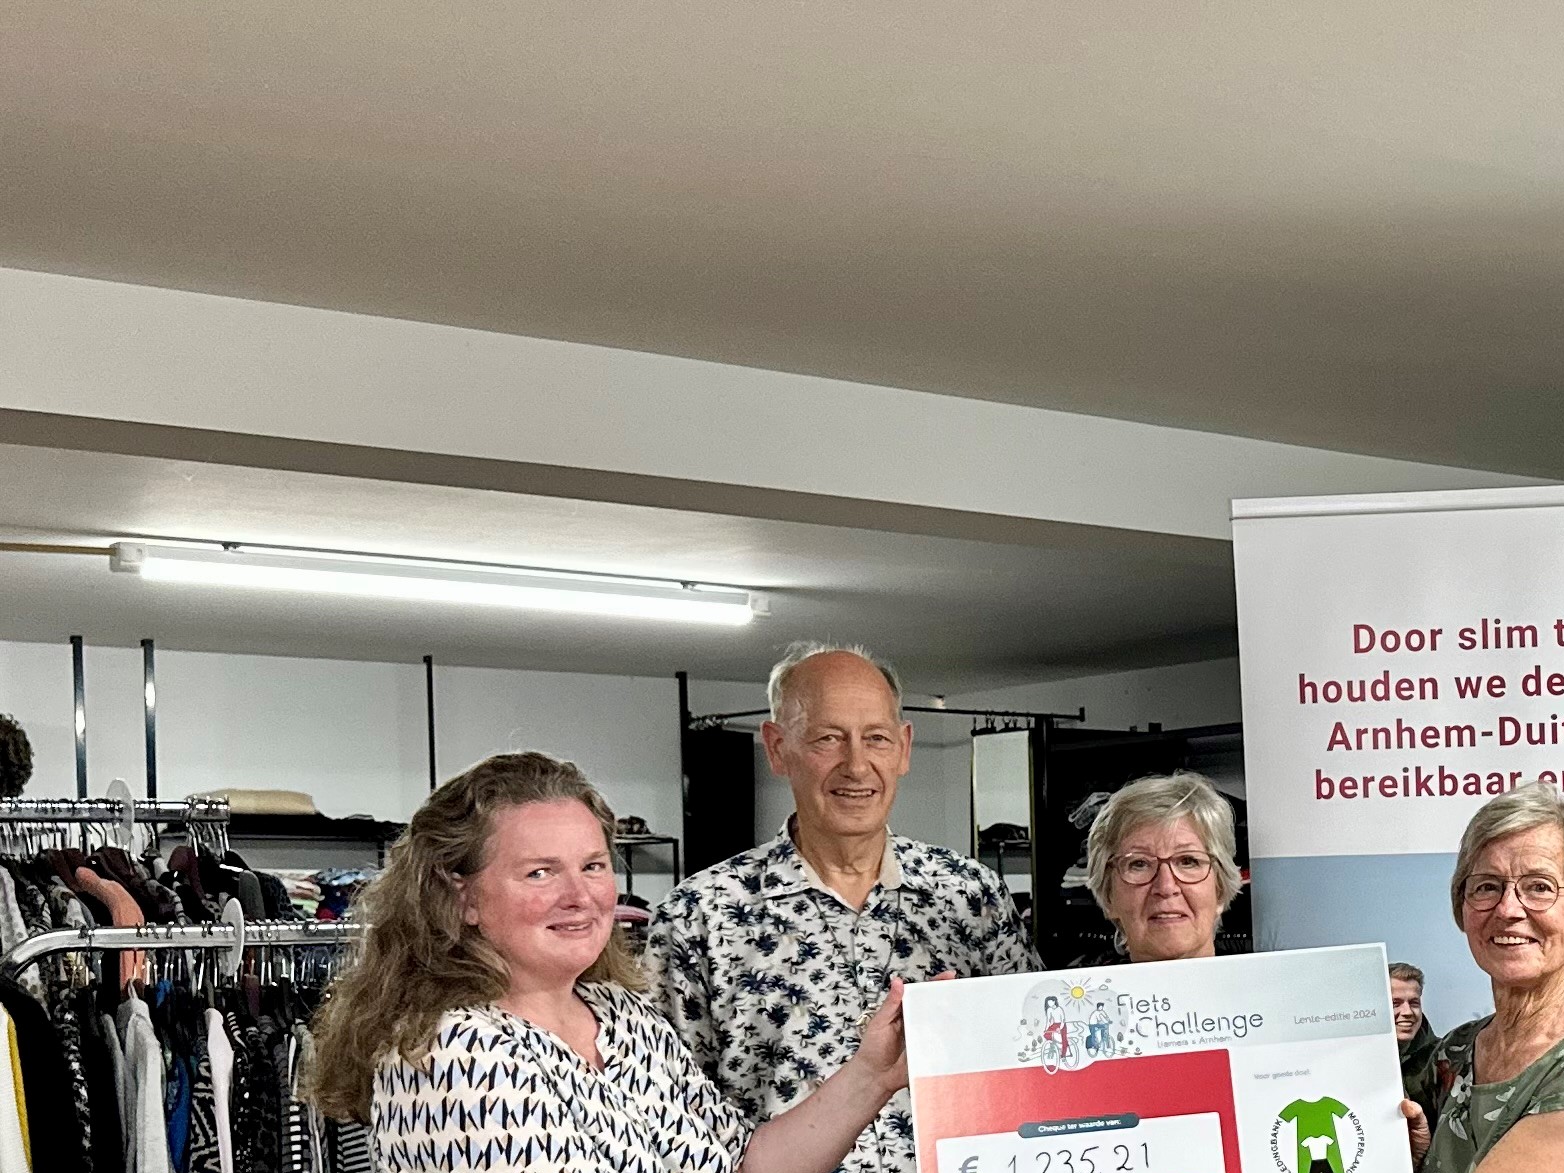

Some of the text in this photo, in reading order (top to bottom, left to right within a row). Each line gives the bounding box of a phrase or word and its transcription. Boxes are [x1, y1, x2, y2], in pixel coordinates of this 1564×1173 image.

[1353, 624, 1443, 654] Door
[1458, 618, 1539, 651] slim
[1299, 670, 1439, 704] houden
[1454, 675, 1506, 699] we
[1315, 765, 1523, 800] bereikbaar
[1116, 994, 1171, 1016] Fiets
[1294, 1009, 1377, 1025] Lente-editie 2024
[1135, 1011, 1264, 1038] Challenge
[1037, 1124, 1067, 1134] Cheque
[1079, 1119, 1105, 1129] waarde
